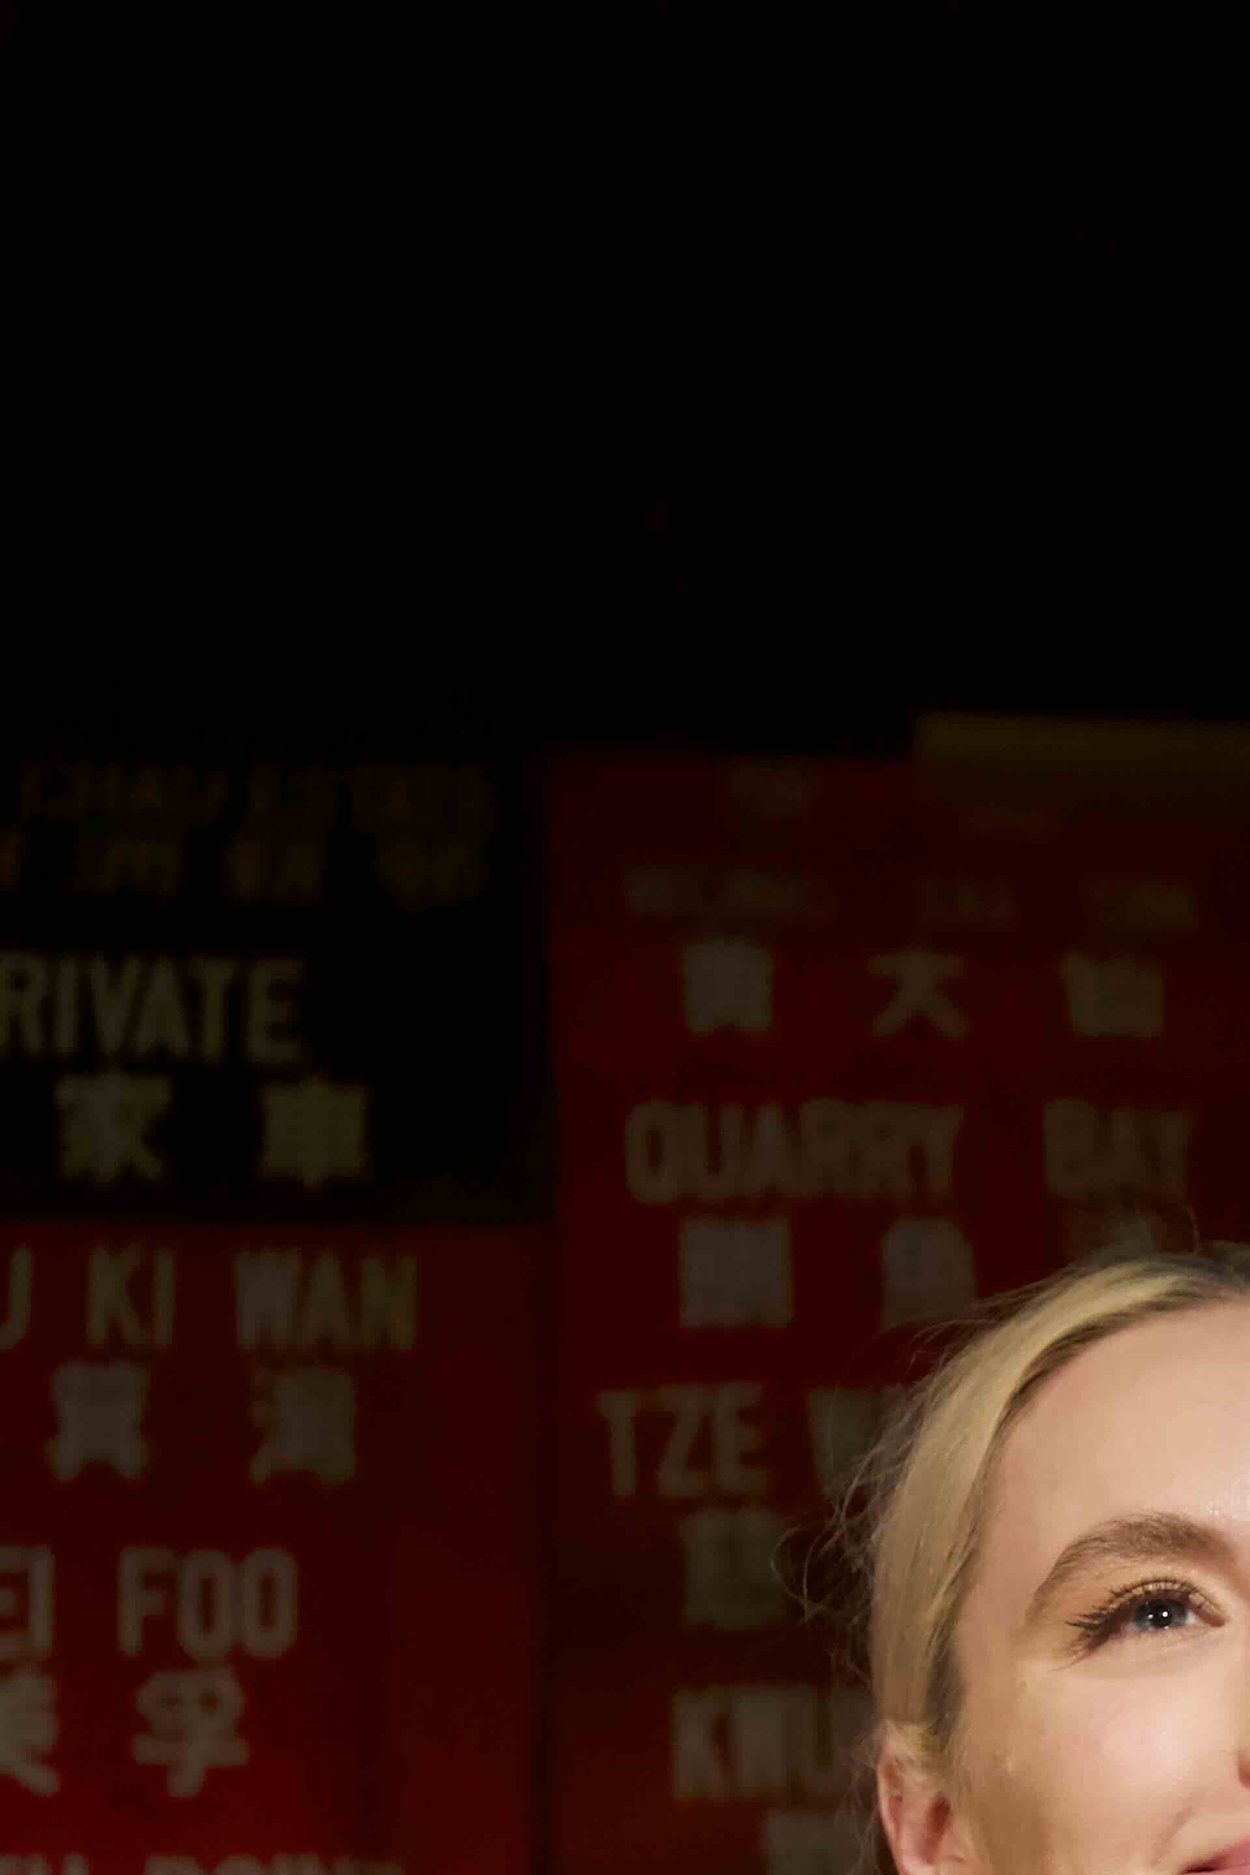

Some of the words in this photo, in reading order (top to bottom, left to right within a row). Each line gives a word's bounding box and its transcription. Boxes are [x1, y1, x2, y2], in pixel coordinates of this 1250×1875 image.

[624, 1100, 964, 1206] QUARRY
[1042, 1098, 1194, 1200] BAY
[86, 1244, 176, 1350] KI
[233, 1248, 417, 1352] WAN
[595, 1380, 769, 1500] TZE
[117, 1544, 298, 1662] FOO
